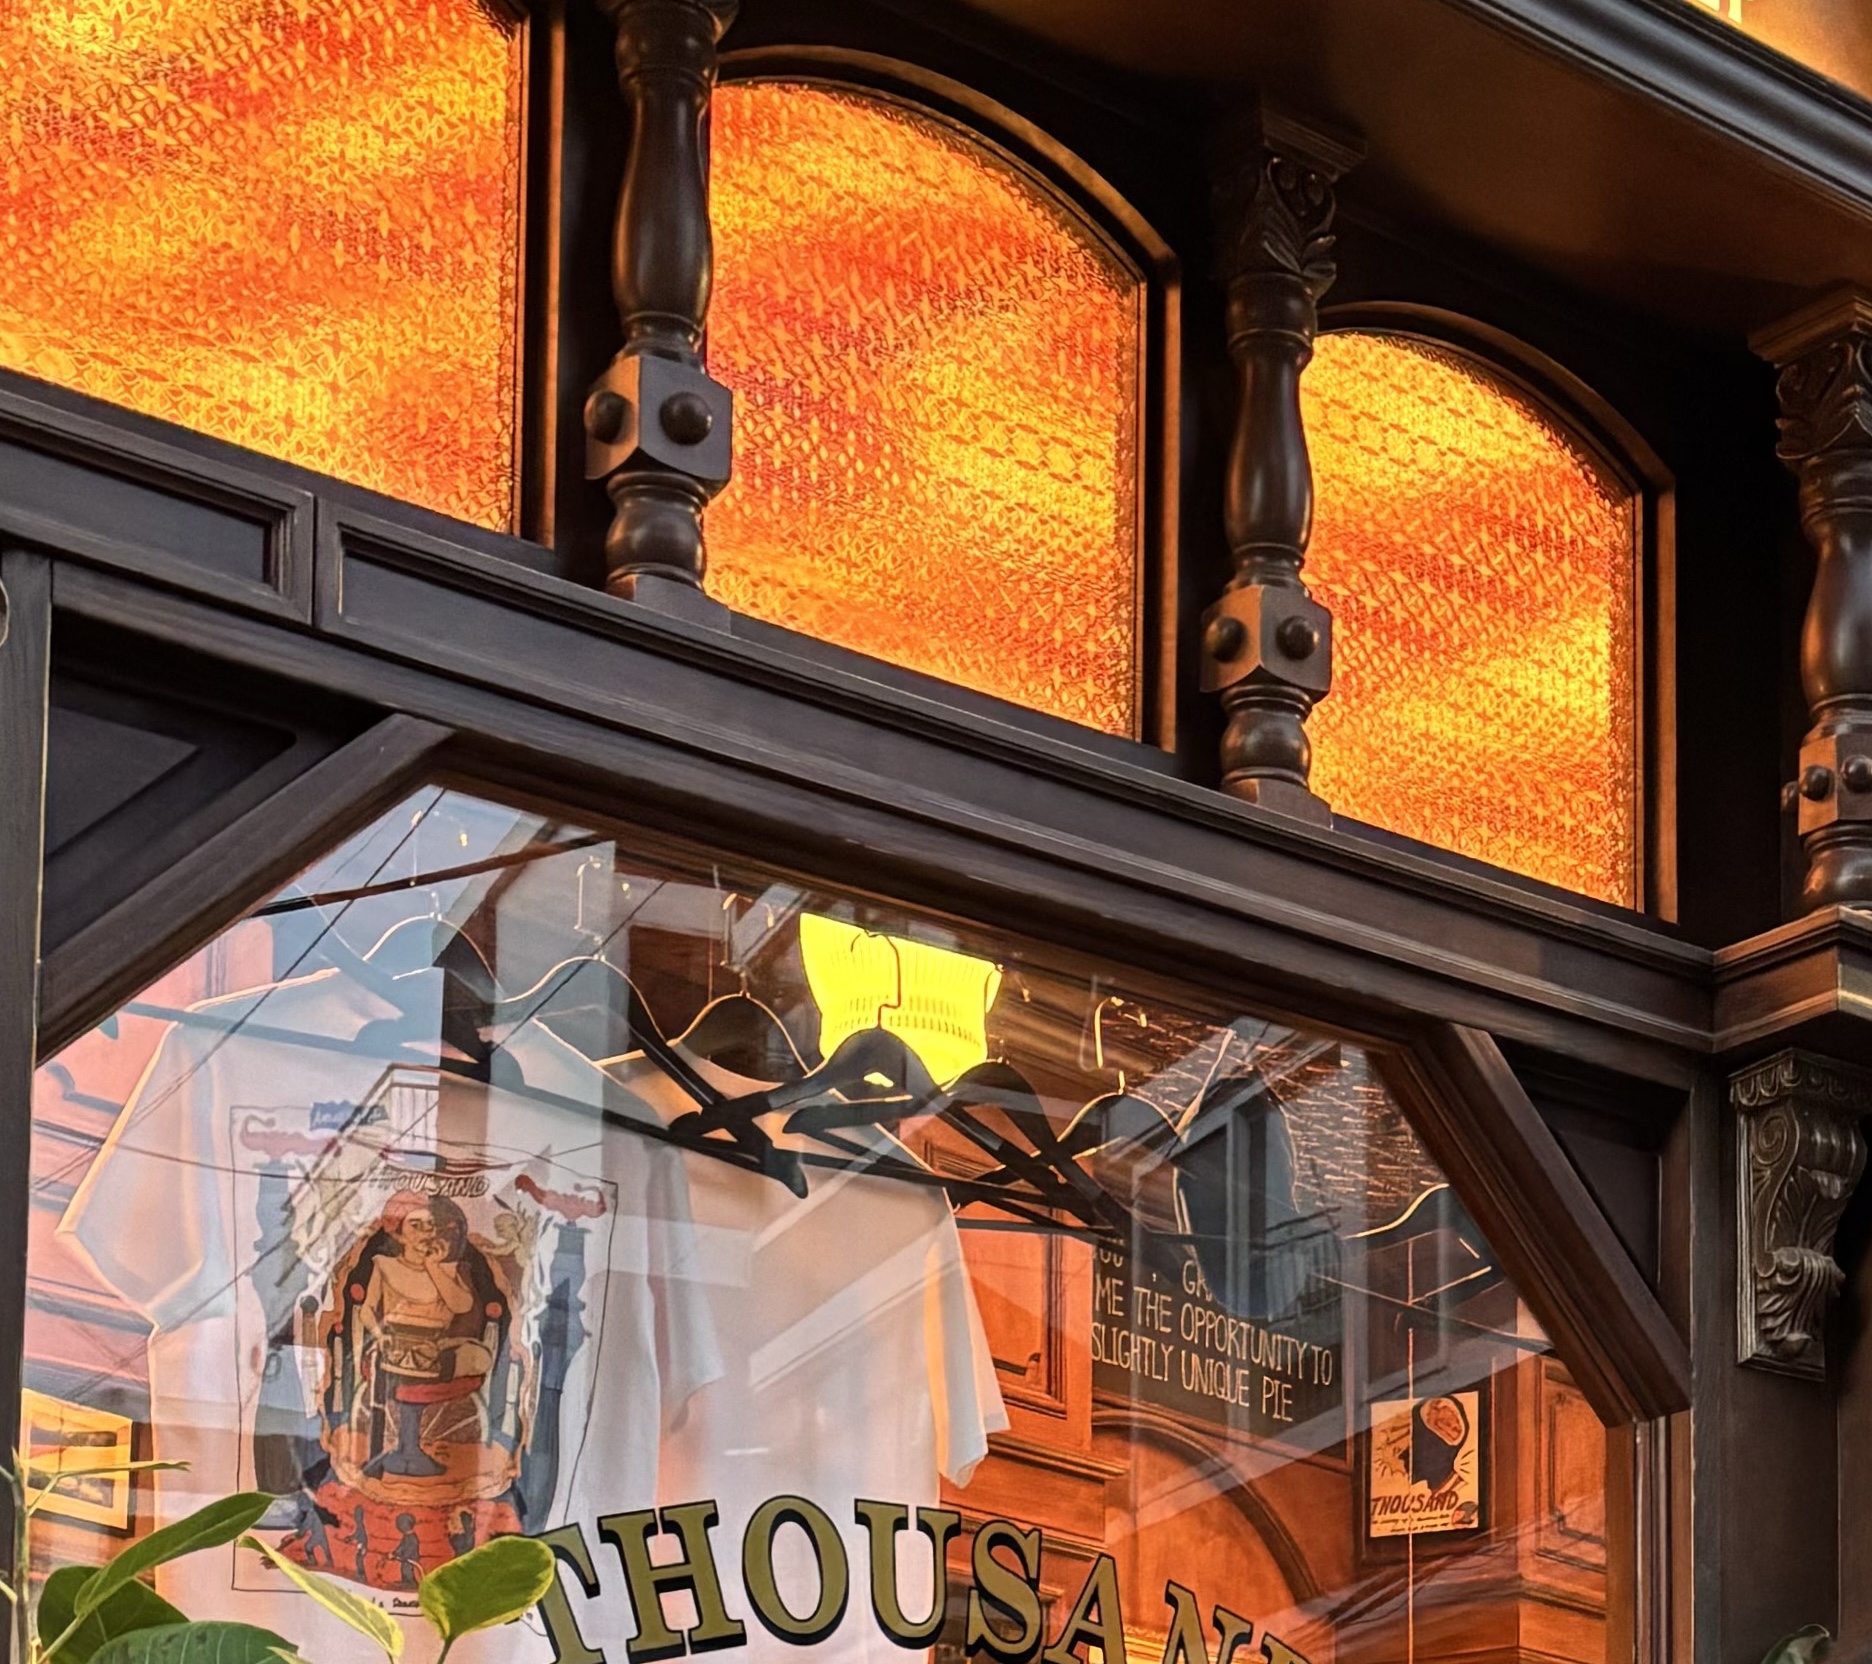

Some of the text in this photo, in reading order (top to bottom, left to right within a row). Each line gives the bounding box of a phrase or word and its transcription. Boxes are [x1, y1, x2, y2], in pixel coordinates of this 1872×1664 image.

[1091, 1322, 1293, 1422] SLIGHTLY UNIQUE PIE
[1095, 1273, 1333, 1386] ME THE OPPORTUNITY TO
[1371, 1490, 1459, 1516] THOUSAND
